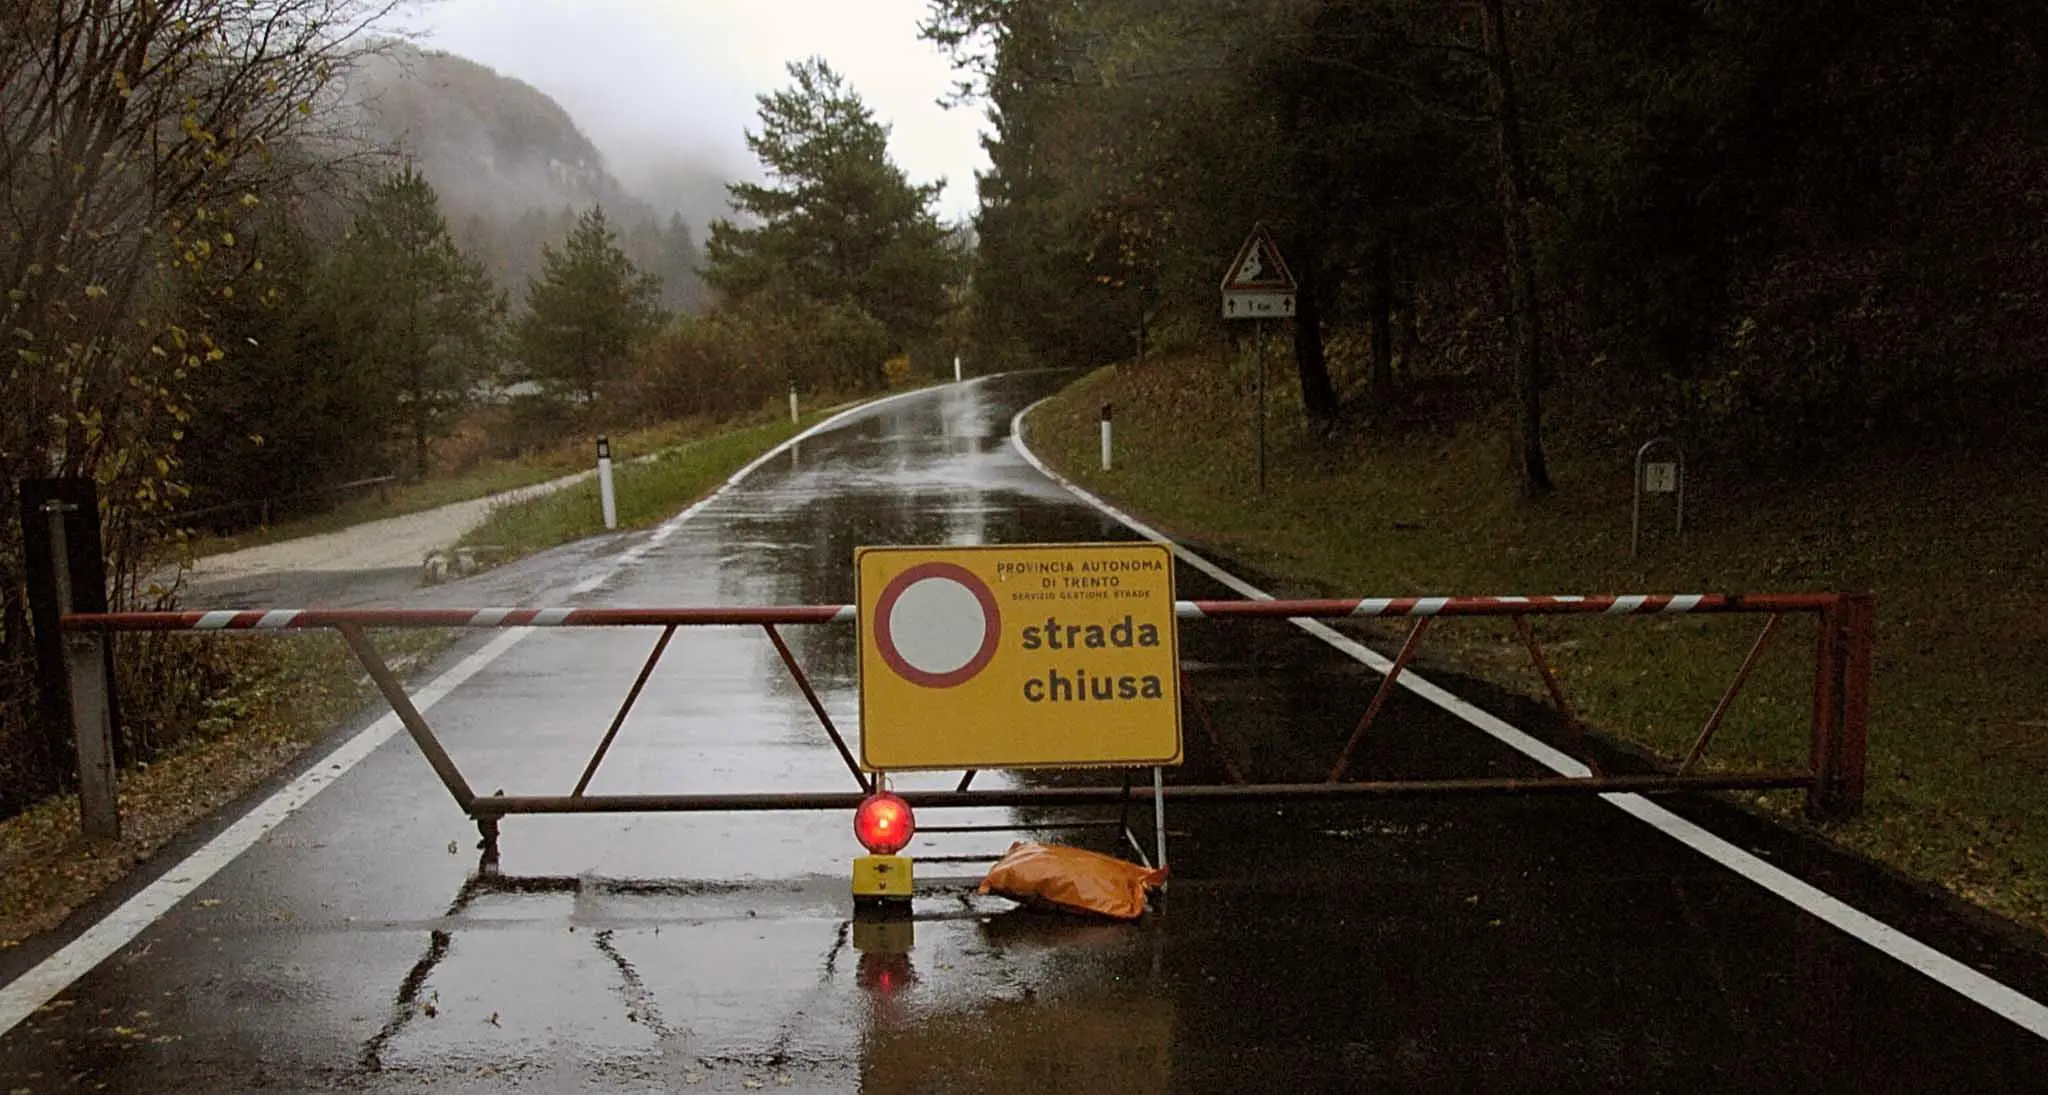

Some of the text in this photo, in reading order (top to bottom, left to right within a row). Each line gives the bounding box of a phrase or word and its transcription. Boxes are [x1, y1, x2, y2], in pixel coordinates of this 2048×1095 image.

[1248, 300, 1254, 312] 1
[997, 559, 1162, 574] PROVINCIA AUTONOMA
[1042, 576, 1120, 588] DI TRENTO
[1012, 589, 1150, 600] SERVIZIO GESTIONE STRADE
[1022, 615, 1160, 649] strada
[1023, 669, 1163, 702] chiusa
